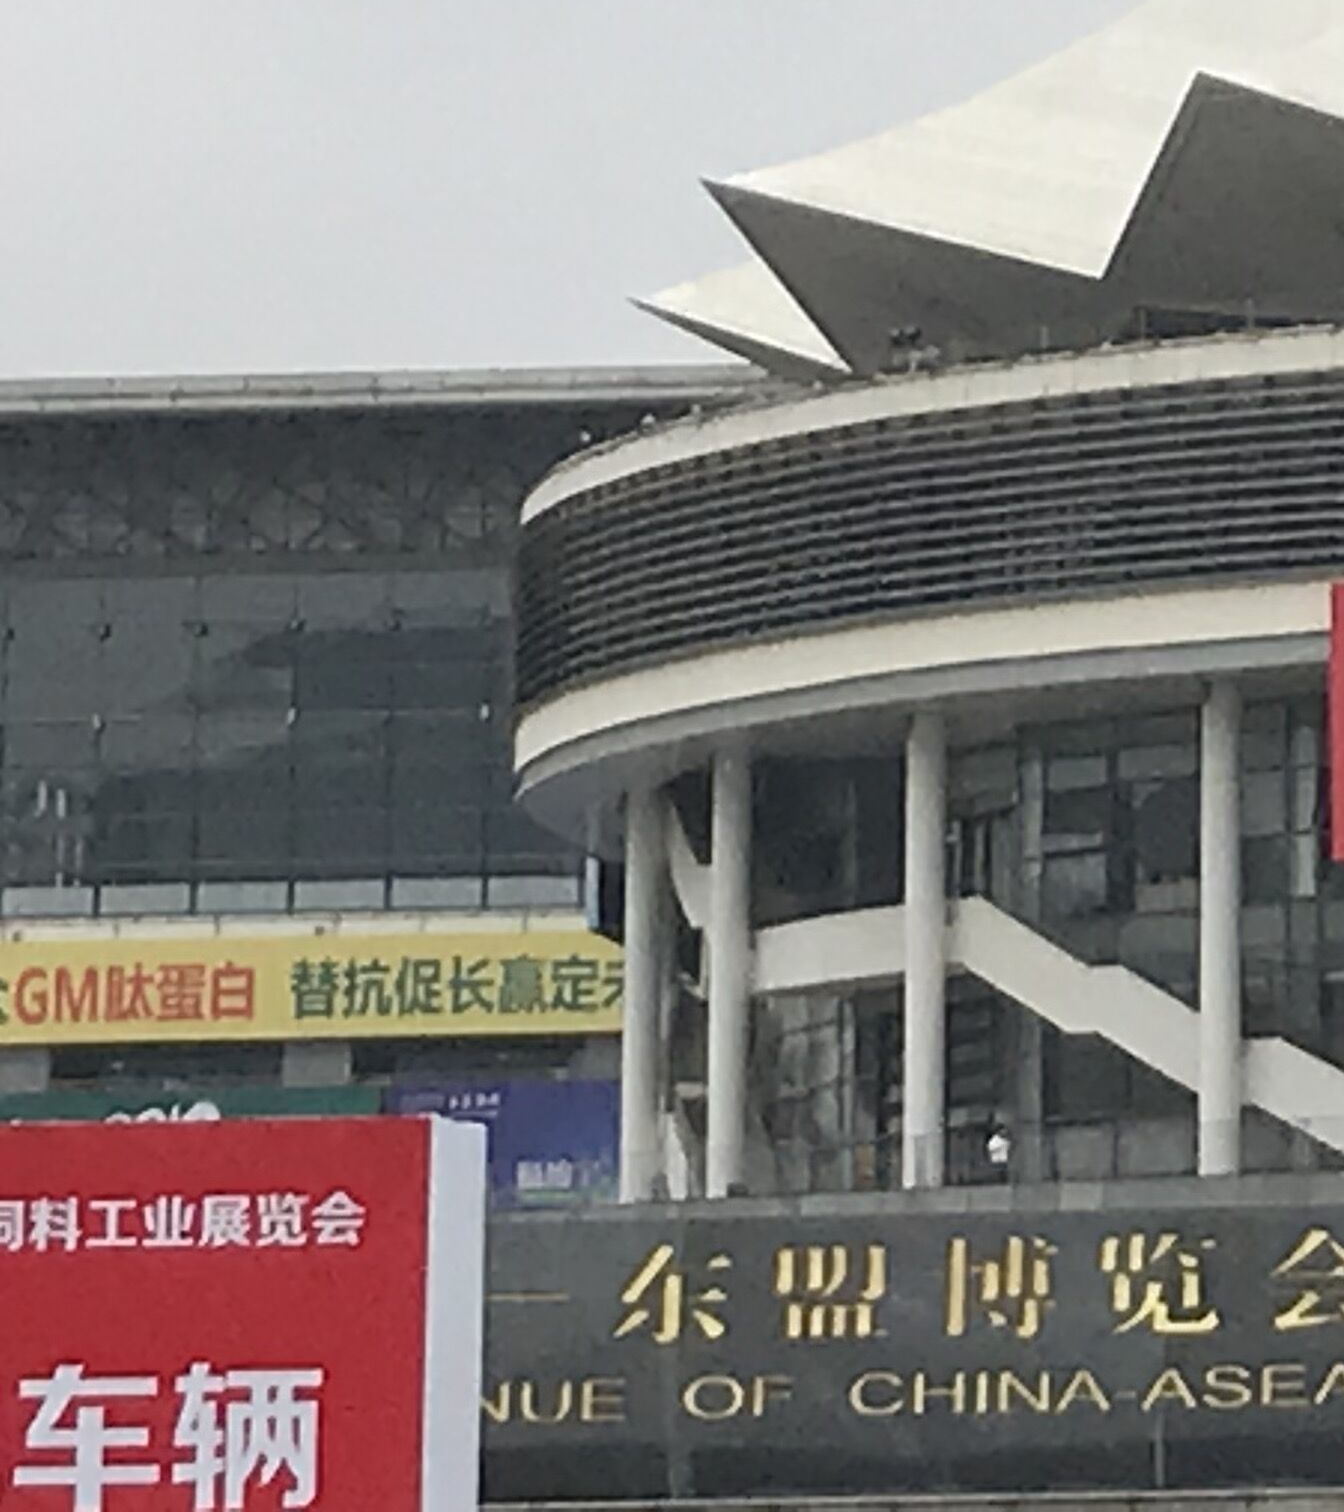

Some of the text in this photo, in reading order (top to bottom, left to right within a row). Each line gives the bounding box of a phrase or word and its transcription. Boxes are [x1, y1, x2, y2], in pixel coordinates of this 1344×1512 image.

[0, 961, 255, 1025] GM肽蛋白
[683, 1374, 794, 1421] OF
[13, 1361, 325, 1512] 车辆
